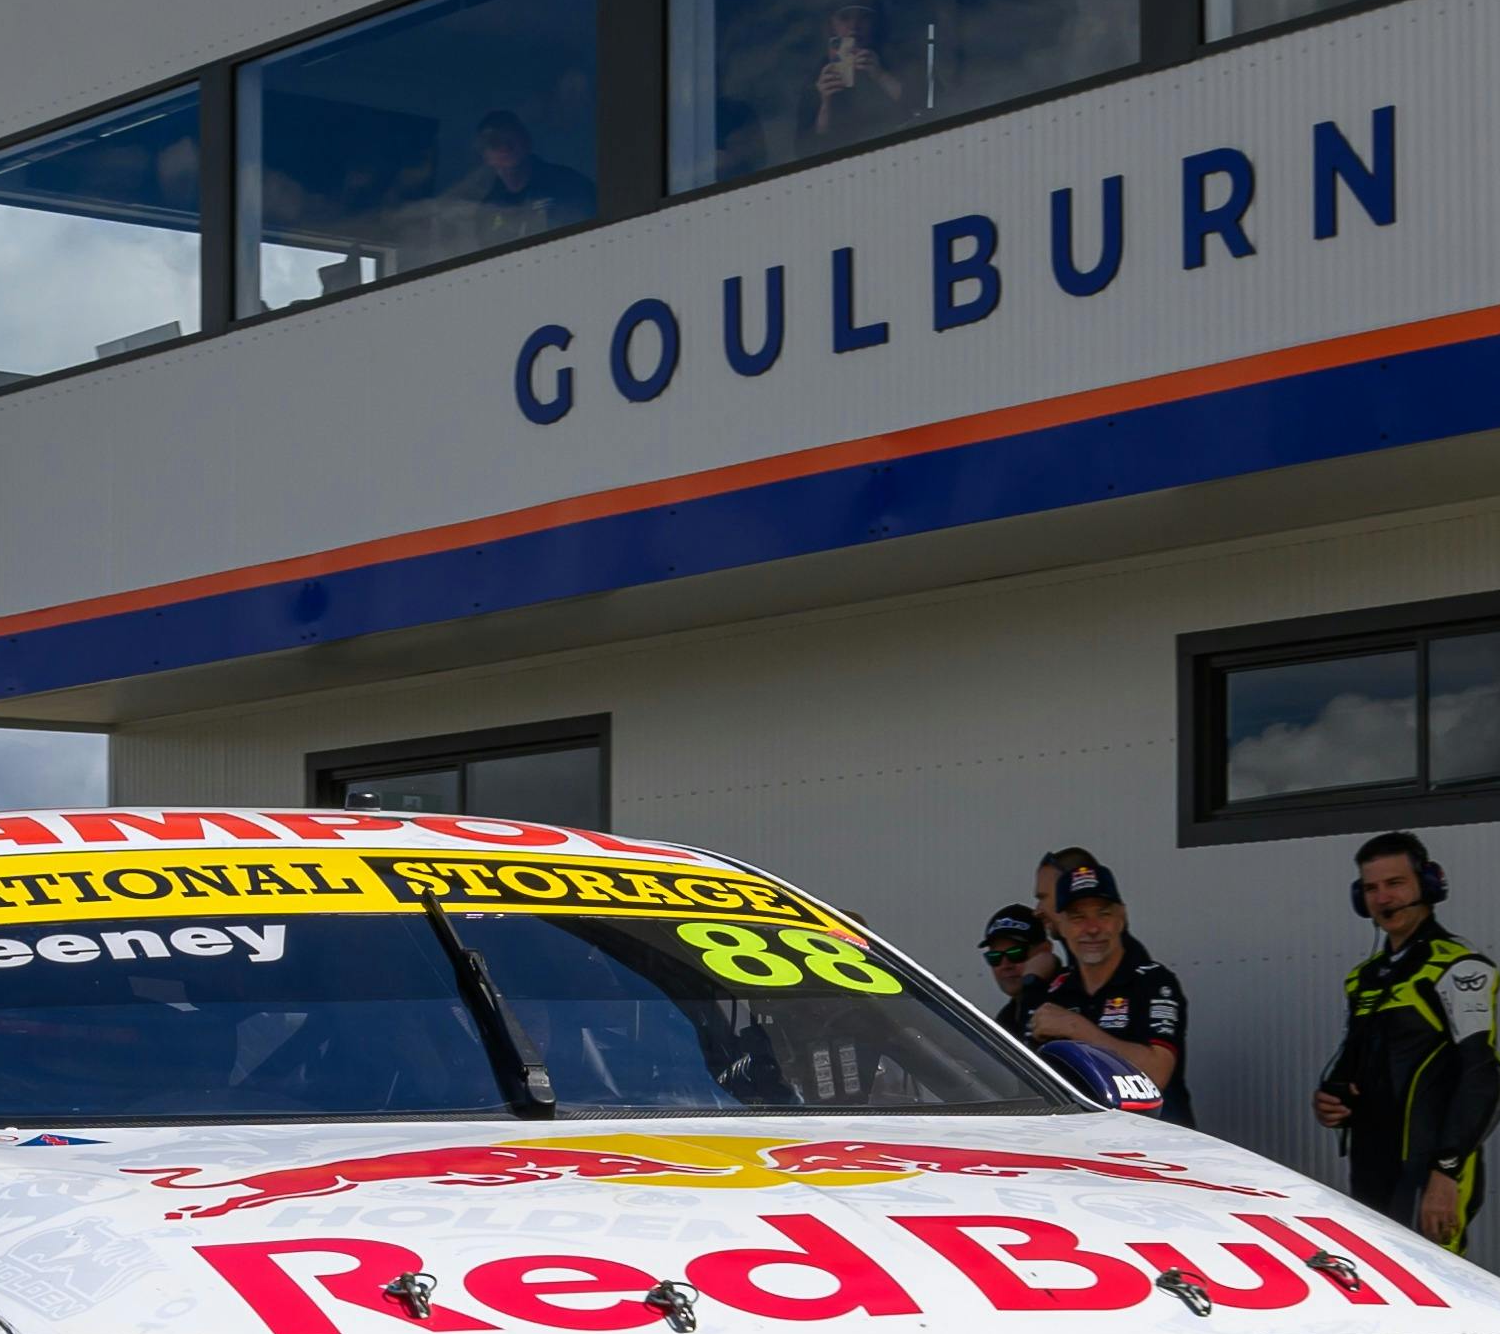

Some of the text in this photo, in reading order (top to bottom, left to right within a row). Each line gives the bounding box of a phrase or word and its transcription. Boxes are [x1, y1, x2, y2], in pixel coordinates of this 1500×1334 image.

[514, 105, 1397, 427] GOULBURN
[392, 859, 803, 920] STORAGE
[676, 922, 903, 995] 88
[886, 1213, 1452, 1311] Bull
